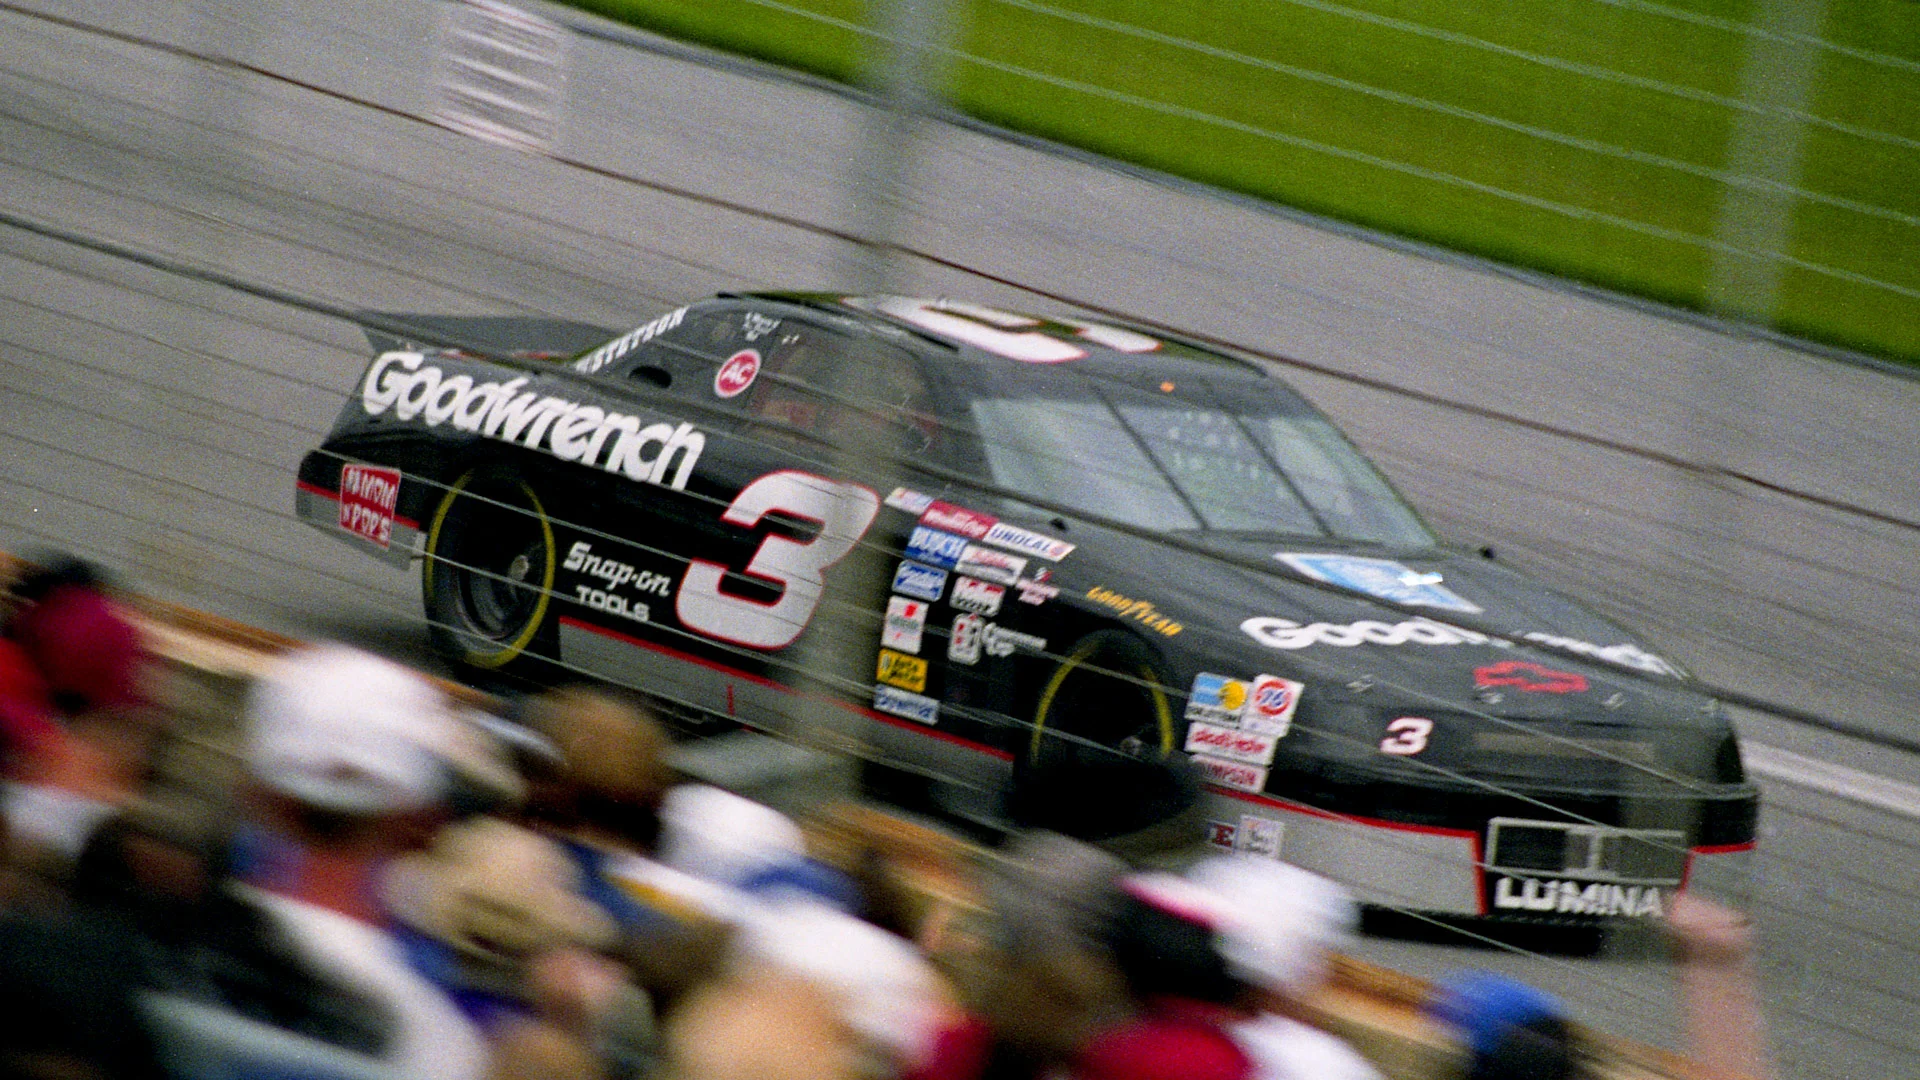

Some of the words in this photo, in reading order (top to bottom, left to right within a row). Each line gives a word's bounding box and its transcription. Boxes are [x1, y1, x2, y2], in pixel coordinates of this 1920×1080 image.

[363, 350, 706, 492] Goodwrench
[991, 527, 1050, 553] UNOCAL
[563, 541, 671, 597] Snap-on
[674, 479, 881, 650] 3
[576, 586, 651, 622] TOOLS
[1380, 716, 1433, 755] 3
[1198, 762, 1257, 786] IMPSON
[1493, 876, 1664, 918] LUMINA
